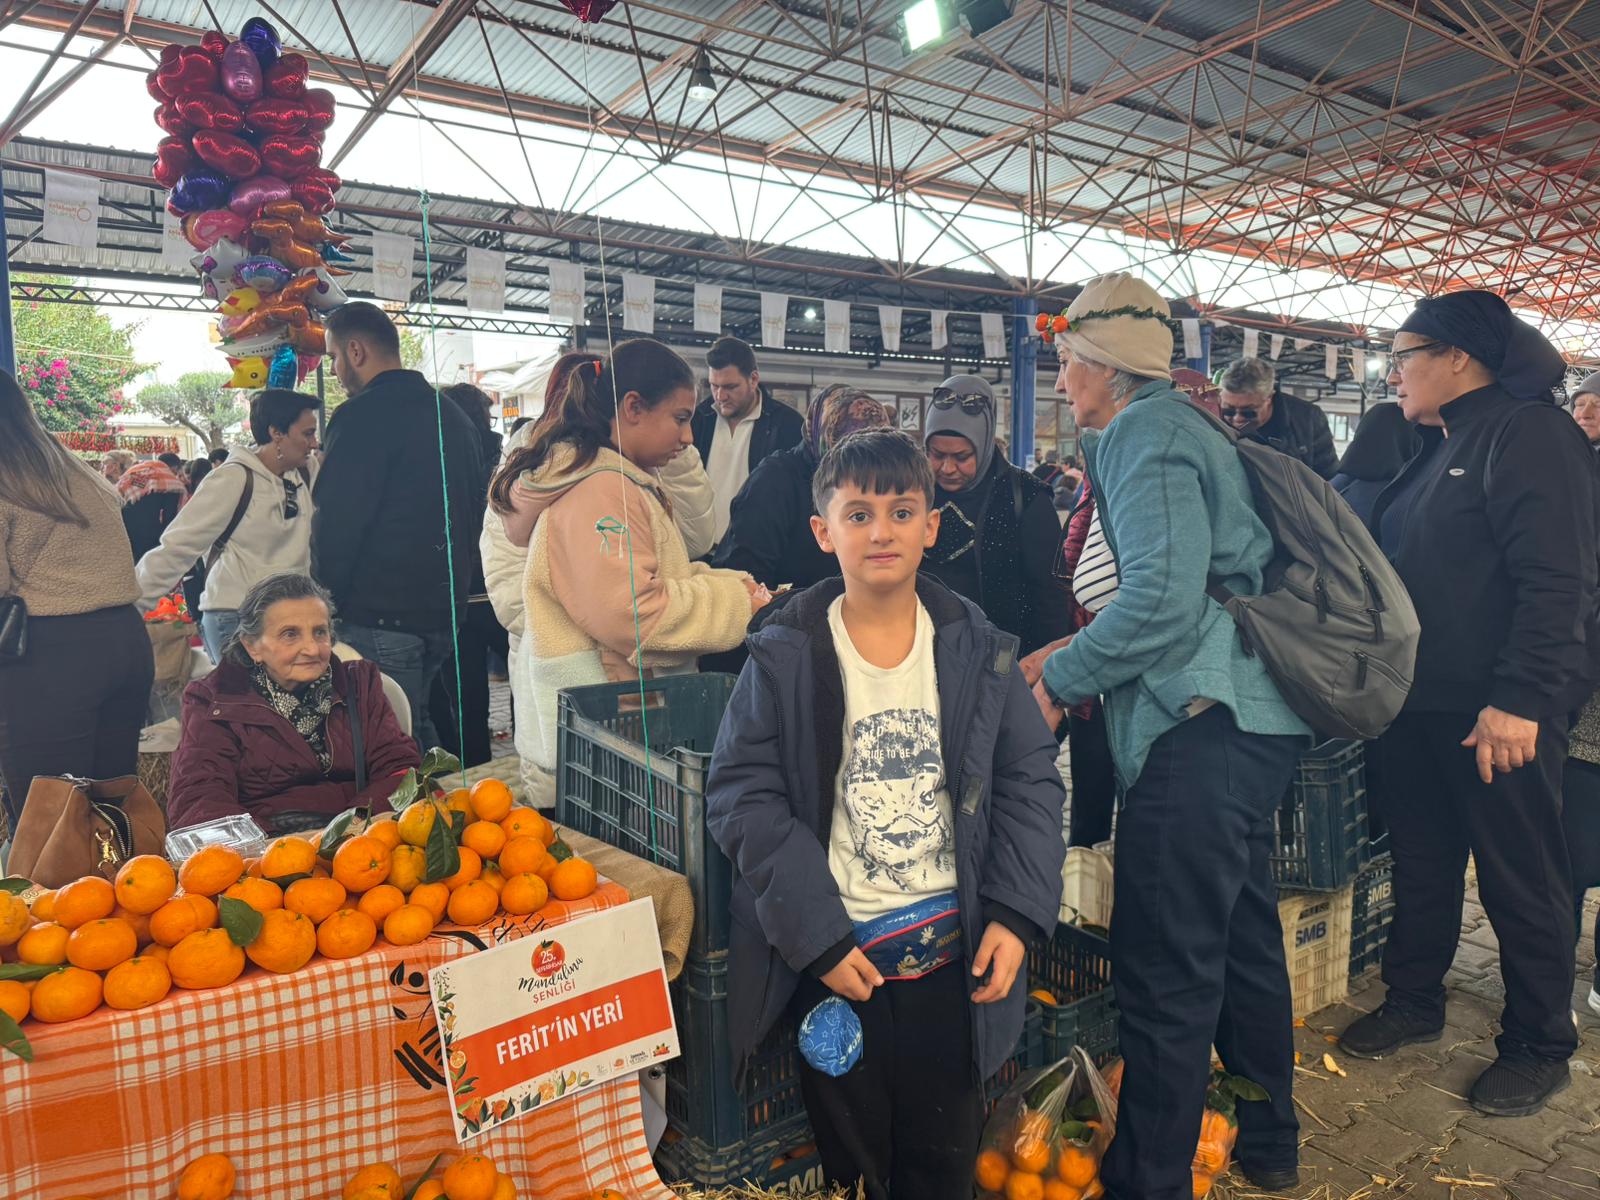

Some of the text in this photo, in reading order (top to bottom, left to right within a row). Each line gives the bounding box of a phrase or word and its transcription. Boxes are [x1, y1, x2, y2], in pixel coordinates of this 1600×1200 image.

[1295, 921, 1327, 949] SMB
[540, 949, 557, 965] 25.
[533, 979, 576, 1004] ŞENLİĞİ
[495, 994, 624, 1066] FERİT'İN YERİ
